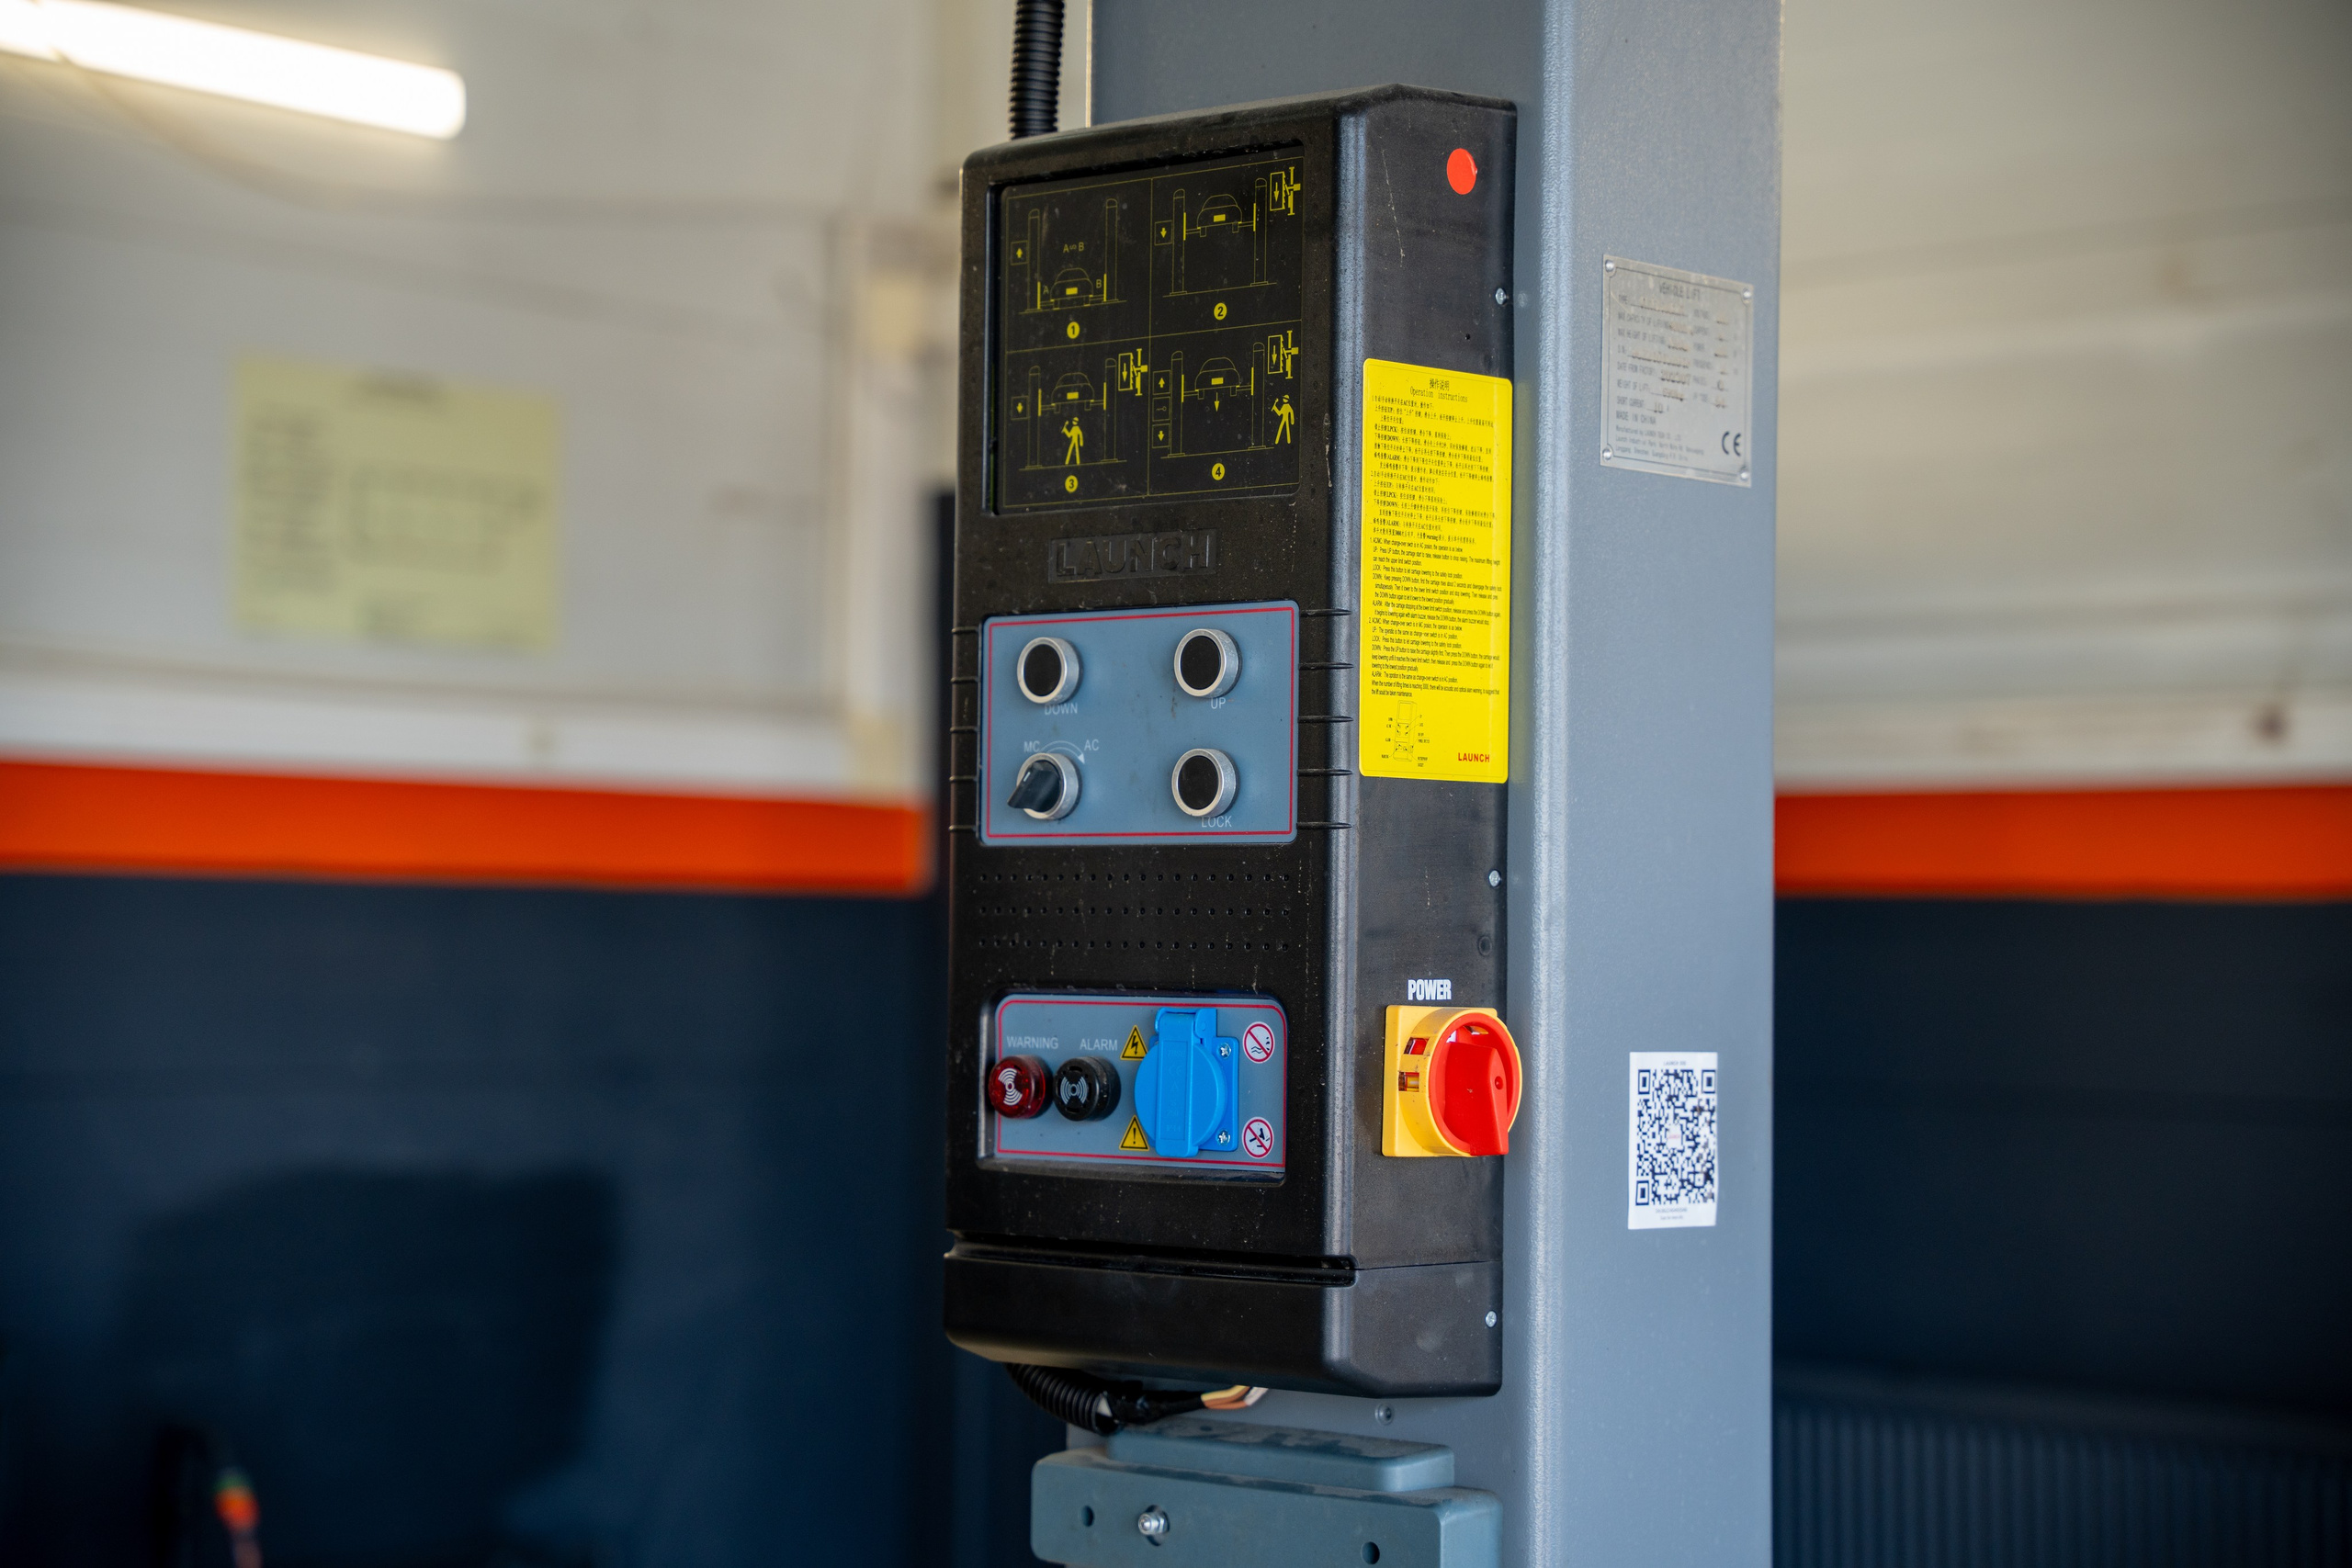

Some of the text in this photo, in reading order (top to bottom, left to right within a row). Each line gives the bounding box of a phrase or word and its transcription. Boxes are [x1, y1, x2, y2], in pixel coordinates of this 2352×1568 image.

[1063, 243, 1084, 253] A B
[1410, 387, 1433, 398] Operation
[1438, 389, 1468, 403] instructions
[1056, 532, 1213, 577] LAUNCH
[1045, 703, 1078, 715] DOWN
[1211, 697, 1226, 709] UP
[1023, 740, 1040, 752] MC
[1084, 739, 1100, 751] AC
[1458, 752, 1490, 762] LAUNCH
[1201, 816, 1232, 829] LOCK
[1408, 979, 1452, 1000] POWER
[1006, 1035, 1059, 1050] WARNING
[1080, 1038, 1118, 1052] ALARM
